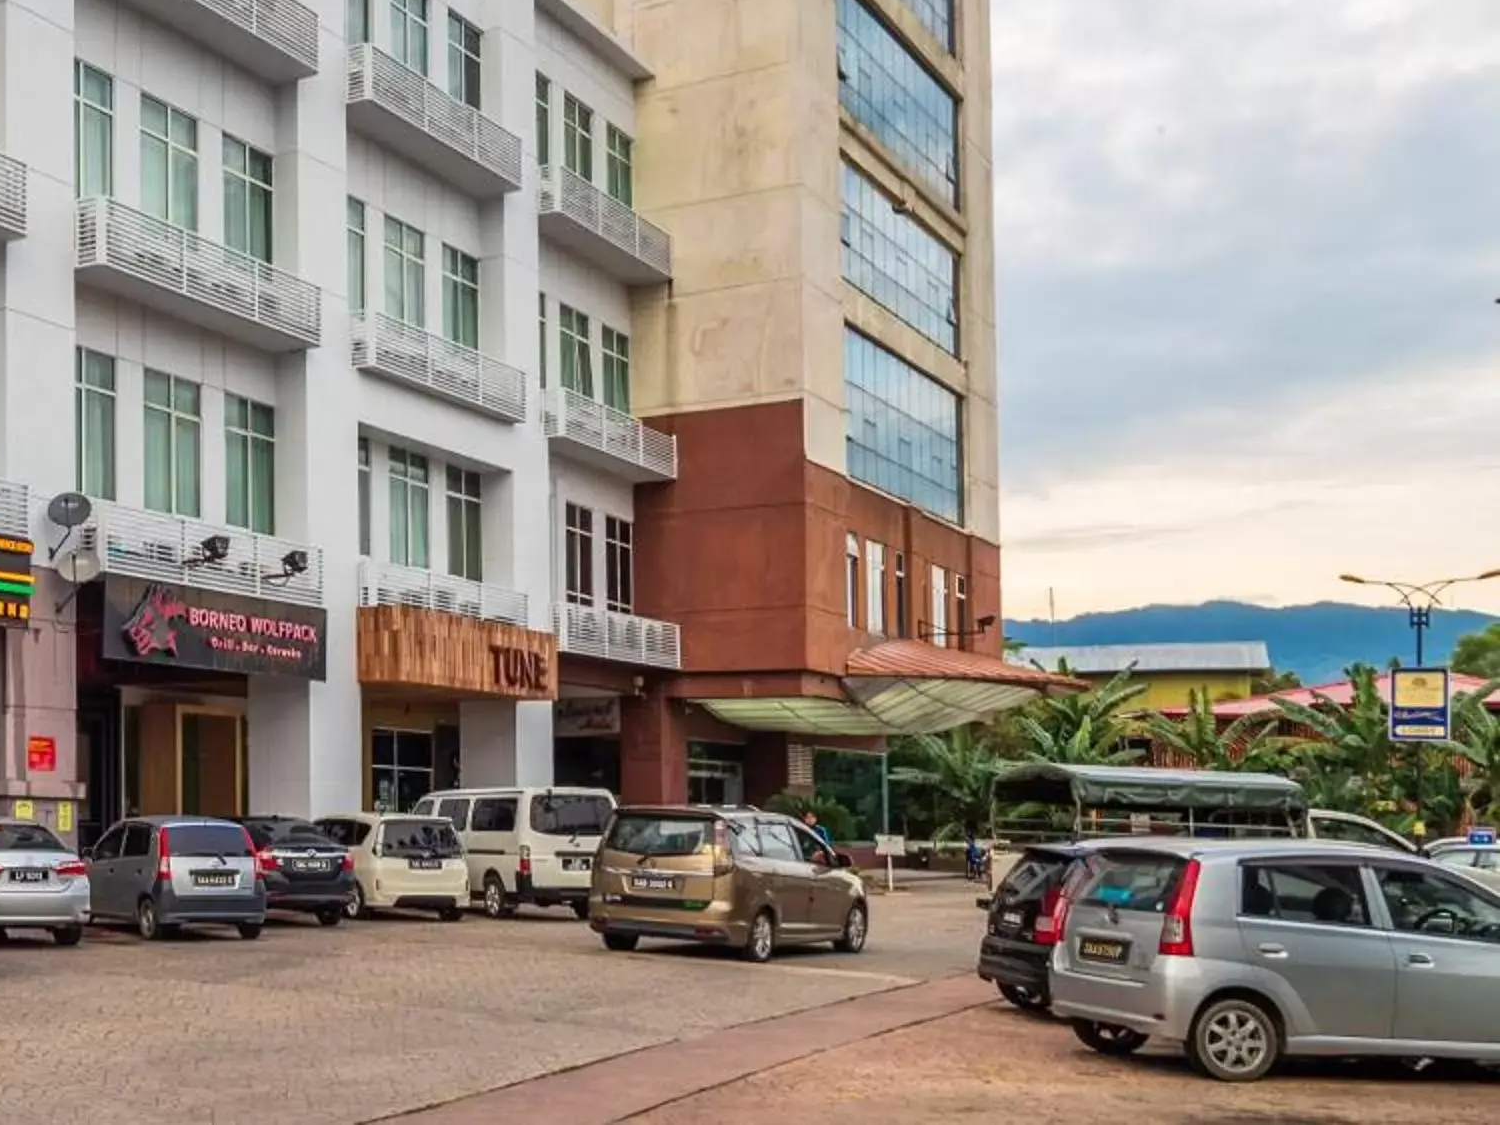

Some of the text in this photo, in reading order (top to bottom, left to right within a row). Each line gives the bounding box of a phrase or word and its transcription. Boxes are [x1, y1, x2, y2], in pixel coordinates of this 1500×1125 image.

[188, 606, 318, 643] BORNEO WOLFPACK
[488, 645, 548, 692] TUNE
